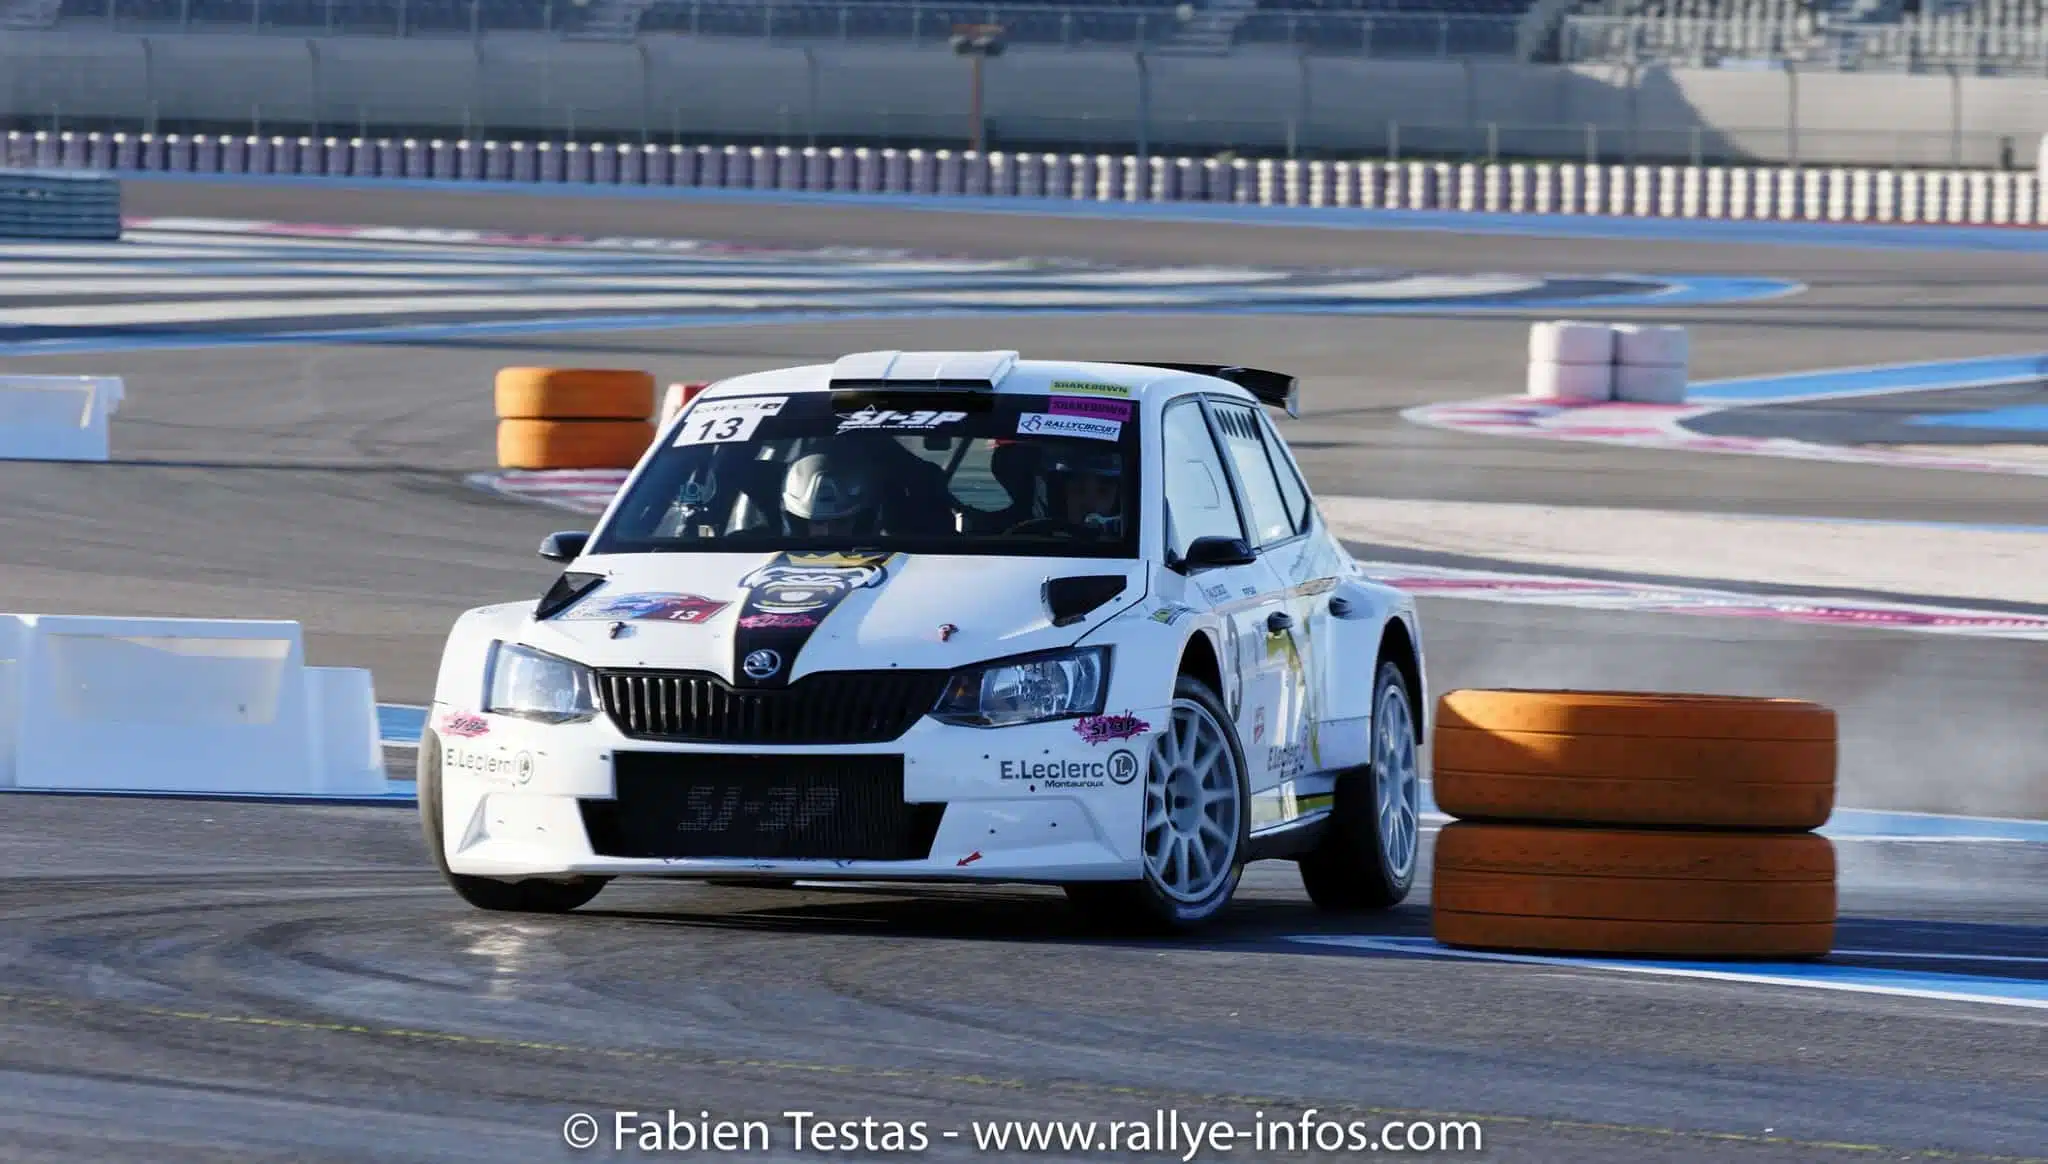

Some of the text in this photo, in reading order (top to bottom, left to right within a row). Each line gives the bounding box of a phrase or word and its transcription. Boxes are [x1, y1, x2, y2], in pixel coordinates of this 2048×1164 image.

[699, 417, 744, 441] 13
[1043, 419, 1118, 434] RALLYCIRCUIT
[669, 610, 700, 620] 13
[1000, 760, 1104, 780] E.Leclerc
[1045, 780, 1104, 788] Montauroux
